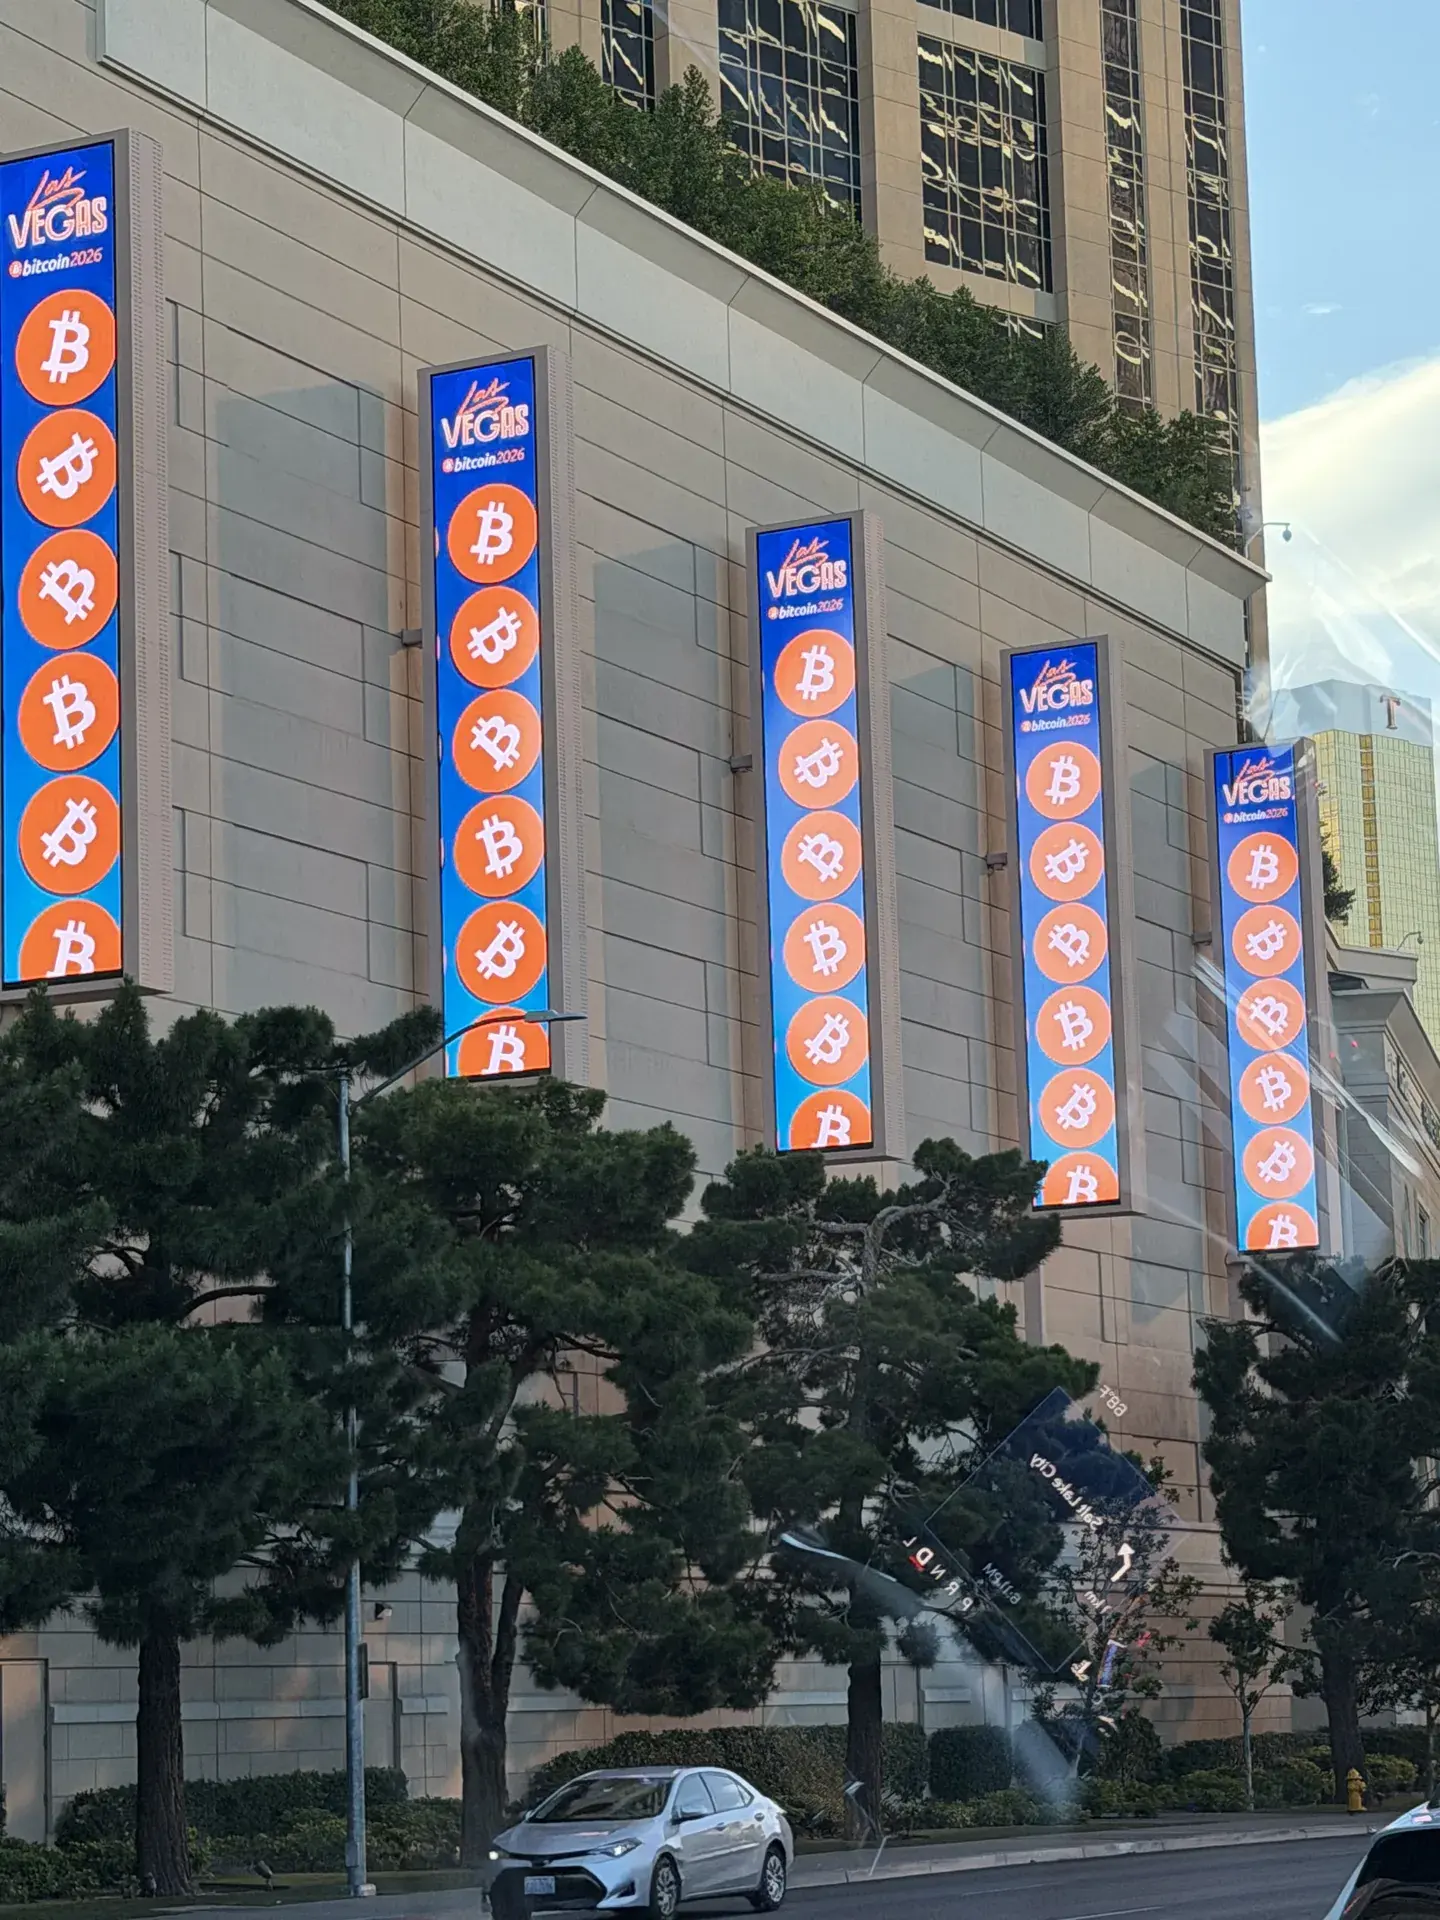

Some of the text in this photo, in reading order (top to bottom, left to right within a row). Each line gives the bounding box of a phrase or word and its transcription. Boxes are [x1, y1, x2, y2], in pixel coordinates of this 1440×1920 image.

[27, 166, 87, 210] Las
[8, 197, 107, 249] VEGAS
[457, 378, 510, 416] Las
[441, 404, 529, 448] VEGAS
[782, 537, 829, 570] Las
[767, 560, 847, 598] VEGAS
[1034, 659, 1077, 687] Las
[1020, 679, 1093, 713] VEGAS
[1380, 694, 1401, 730] T
[1222, 776, 1291, 807] VEGAS
